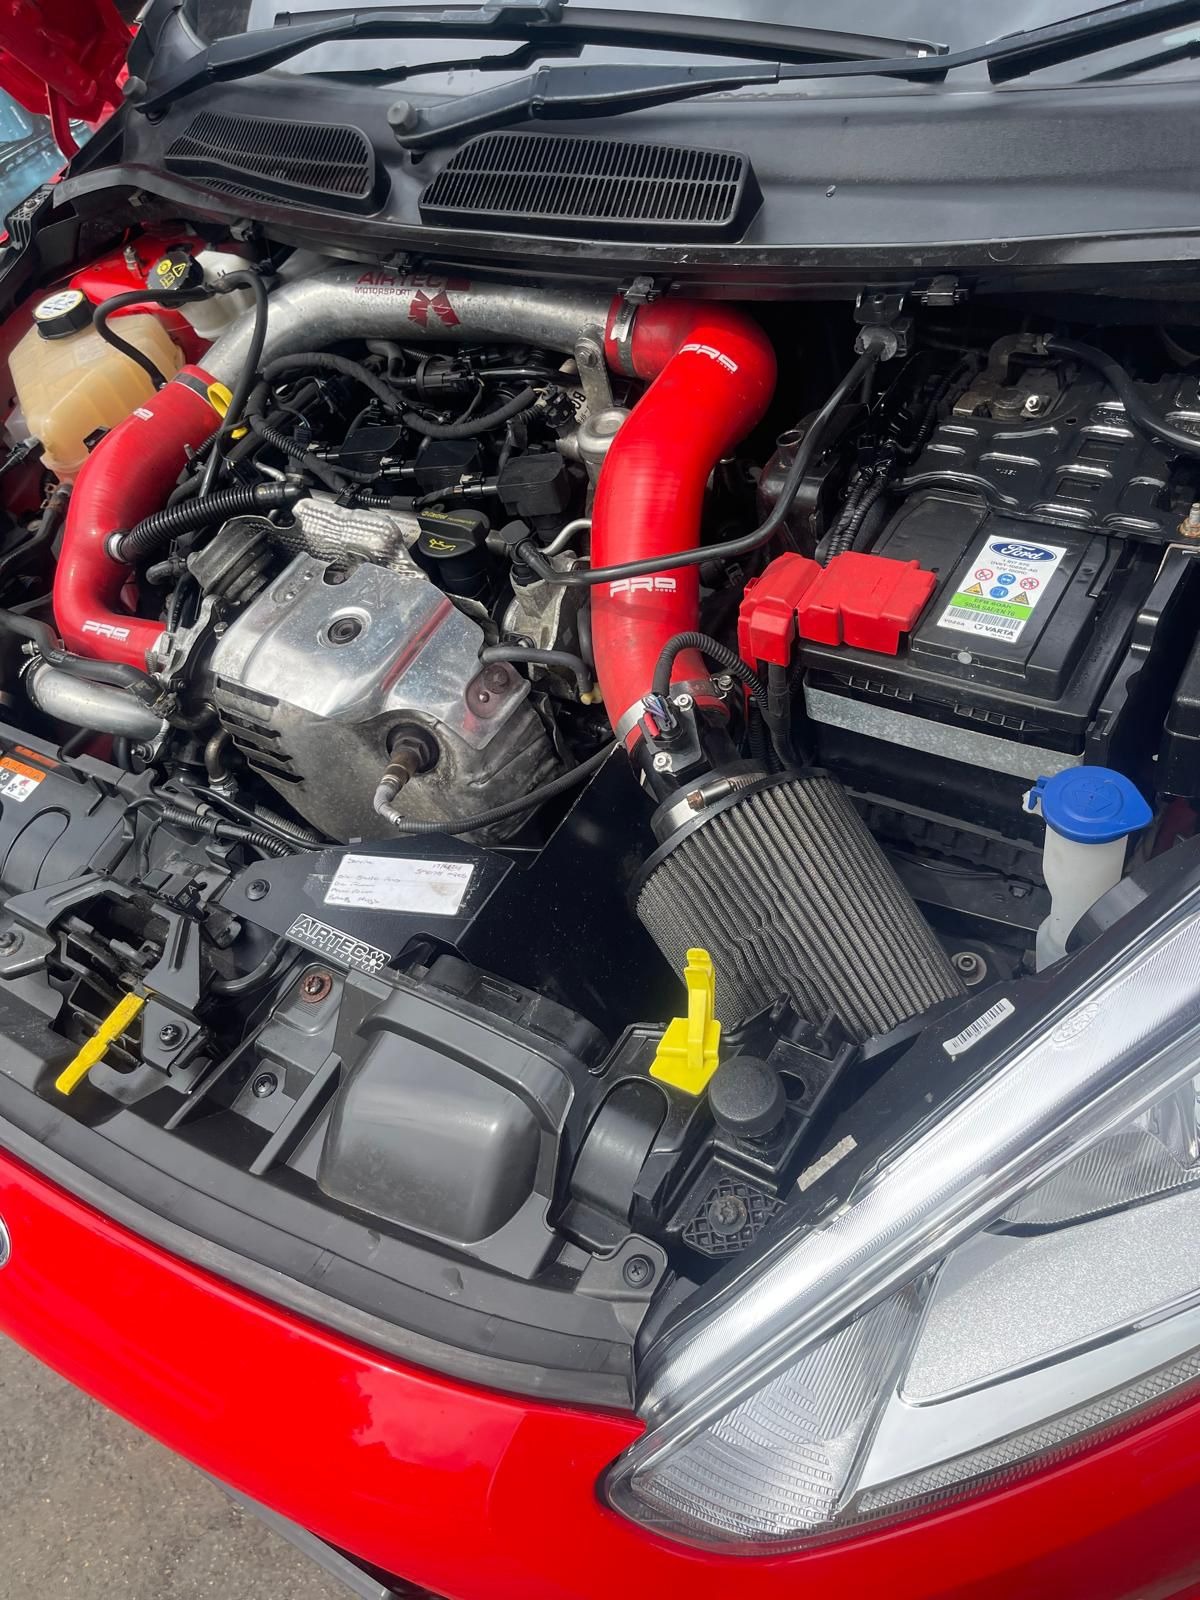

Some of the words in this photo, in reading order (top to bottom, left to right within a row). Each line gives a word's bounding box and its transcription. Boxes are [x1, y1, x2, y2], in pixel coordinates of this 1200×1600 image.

[354, 286, 412, 297] MOTORSPORT
[1000, 543, 1045, 561] Ford
[610, 577, 676, 598] PRO
[82, 620, 130, 639] PRO
[985, 625, 1014, 636] VARTA
[293, 918, 370, 961] AIRTEC
